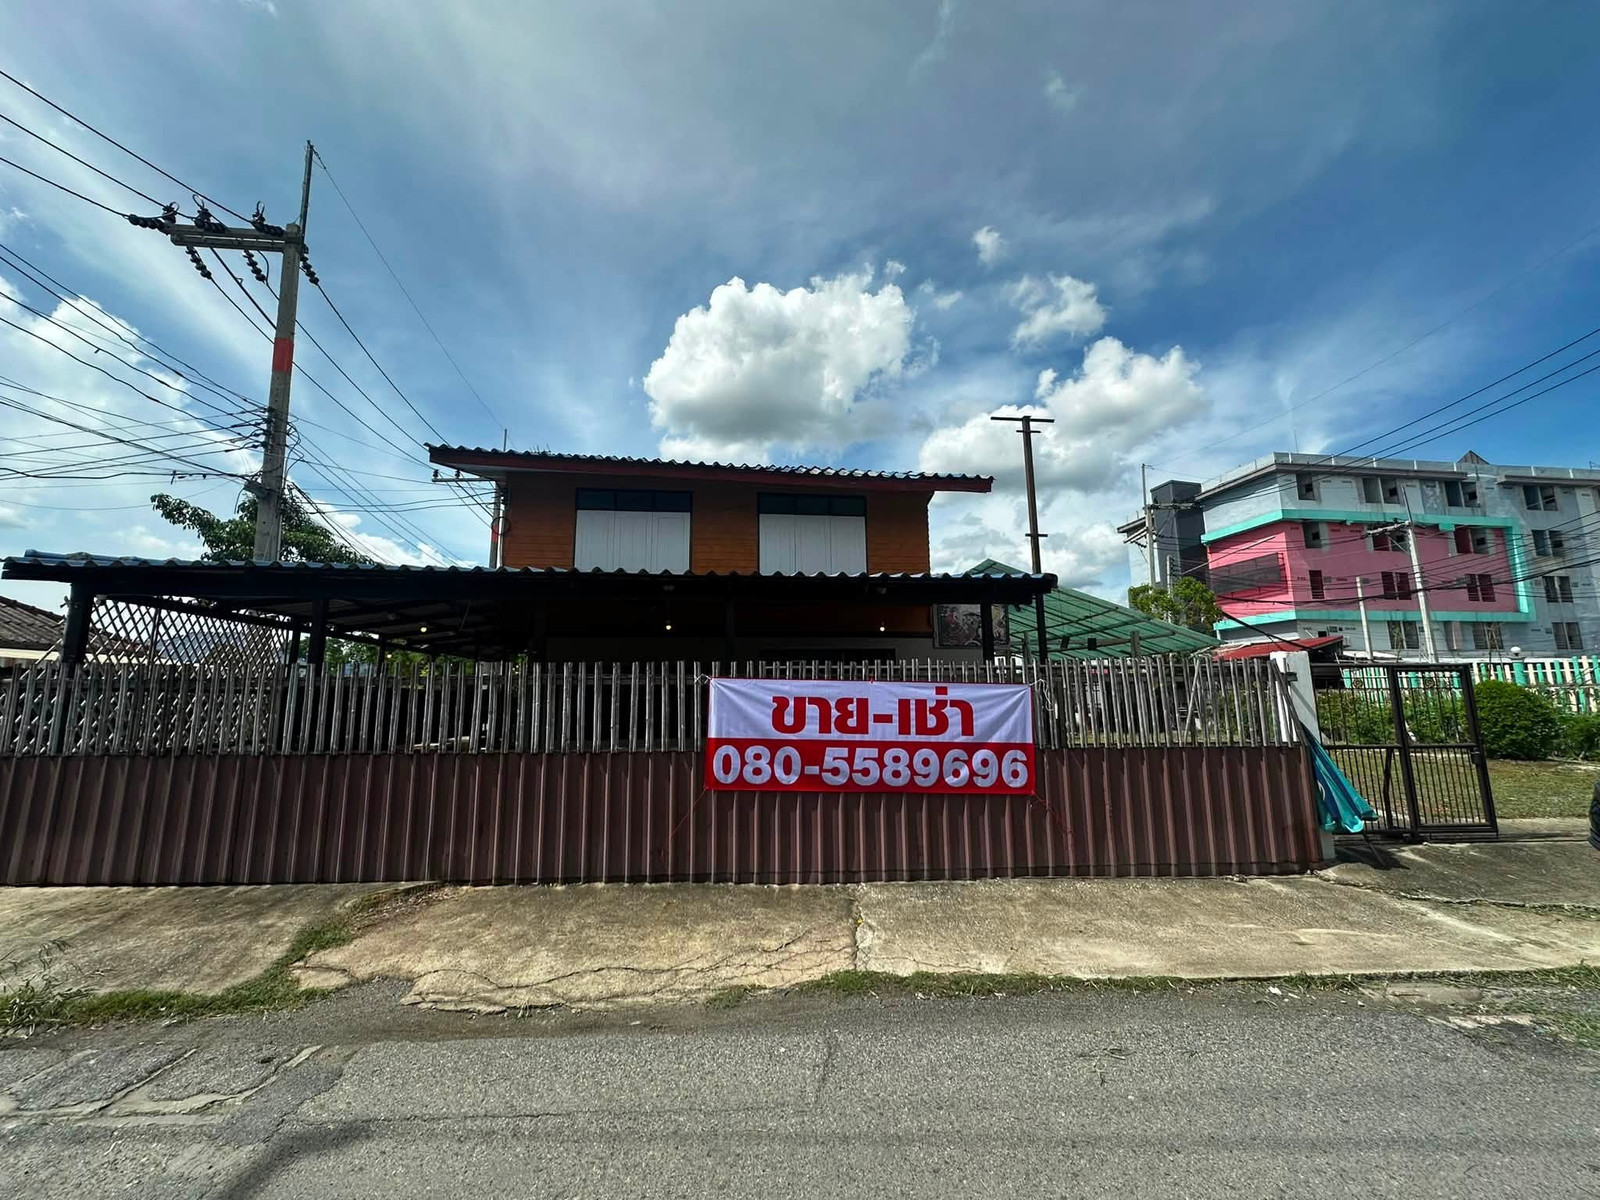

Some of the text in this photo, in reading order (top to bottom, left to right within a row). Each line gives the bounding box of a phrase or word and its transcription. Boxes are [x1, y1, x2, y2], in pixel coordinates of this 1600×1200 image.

[771, 686, 975, 737] ขาย-เช่า
[712, 744, 1029, 788] 080-5589696
